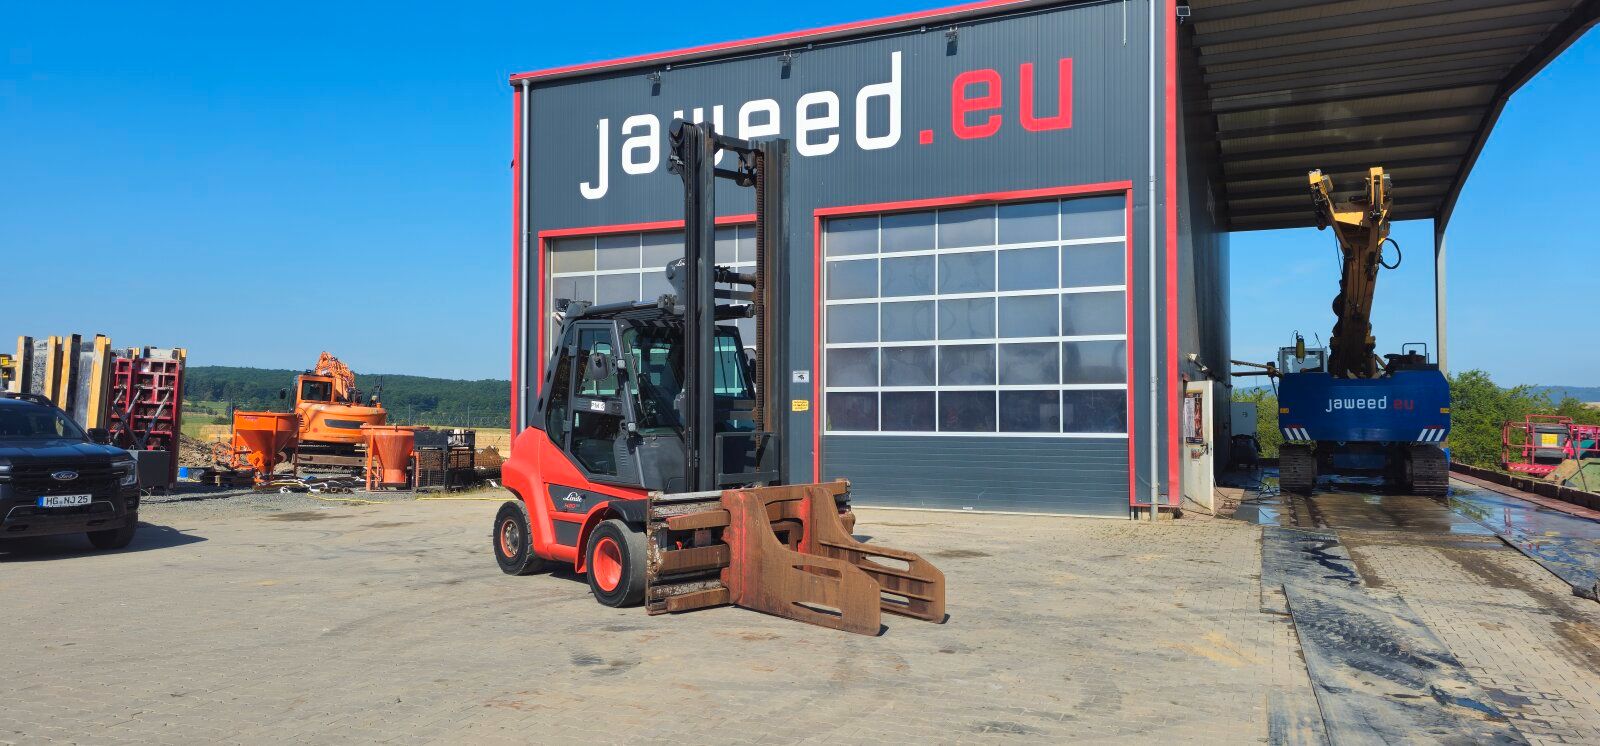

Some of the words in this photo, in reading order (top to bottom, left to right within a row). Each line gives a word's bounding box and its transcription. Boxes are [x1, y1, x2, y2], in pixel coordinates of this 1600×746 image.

[47, 496, 59, 505] HG
[63, 496, 76, 504] NJ
[77, 495, 89, 504] 25
[562, 491, 582, 503] Linde
